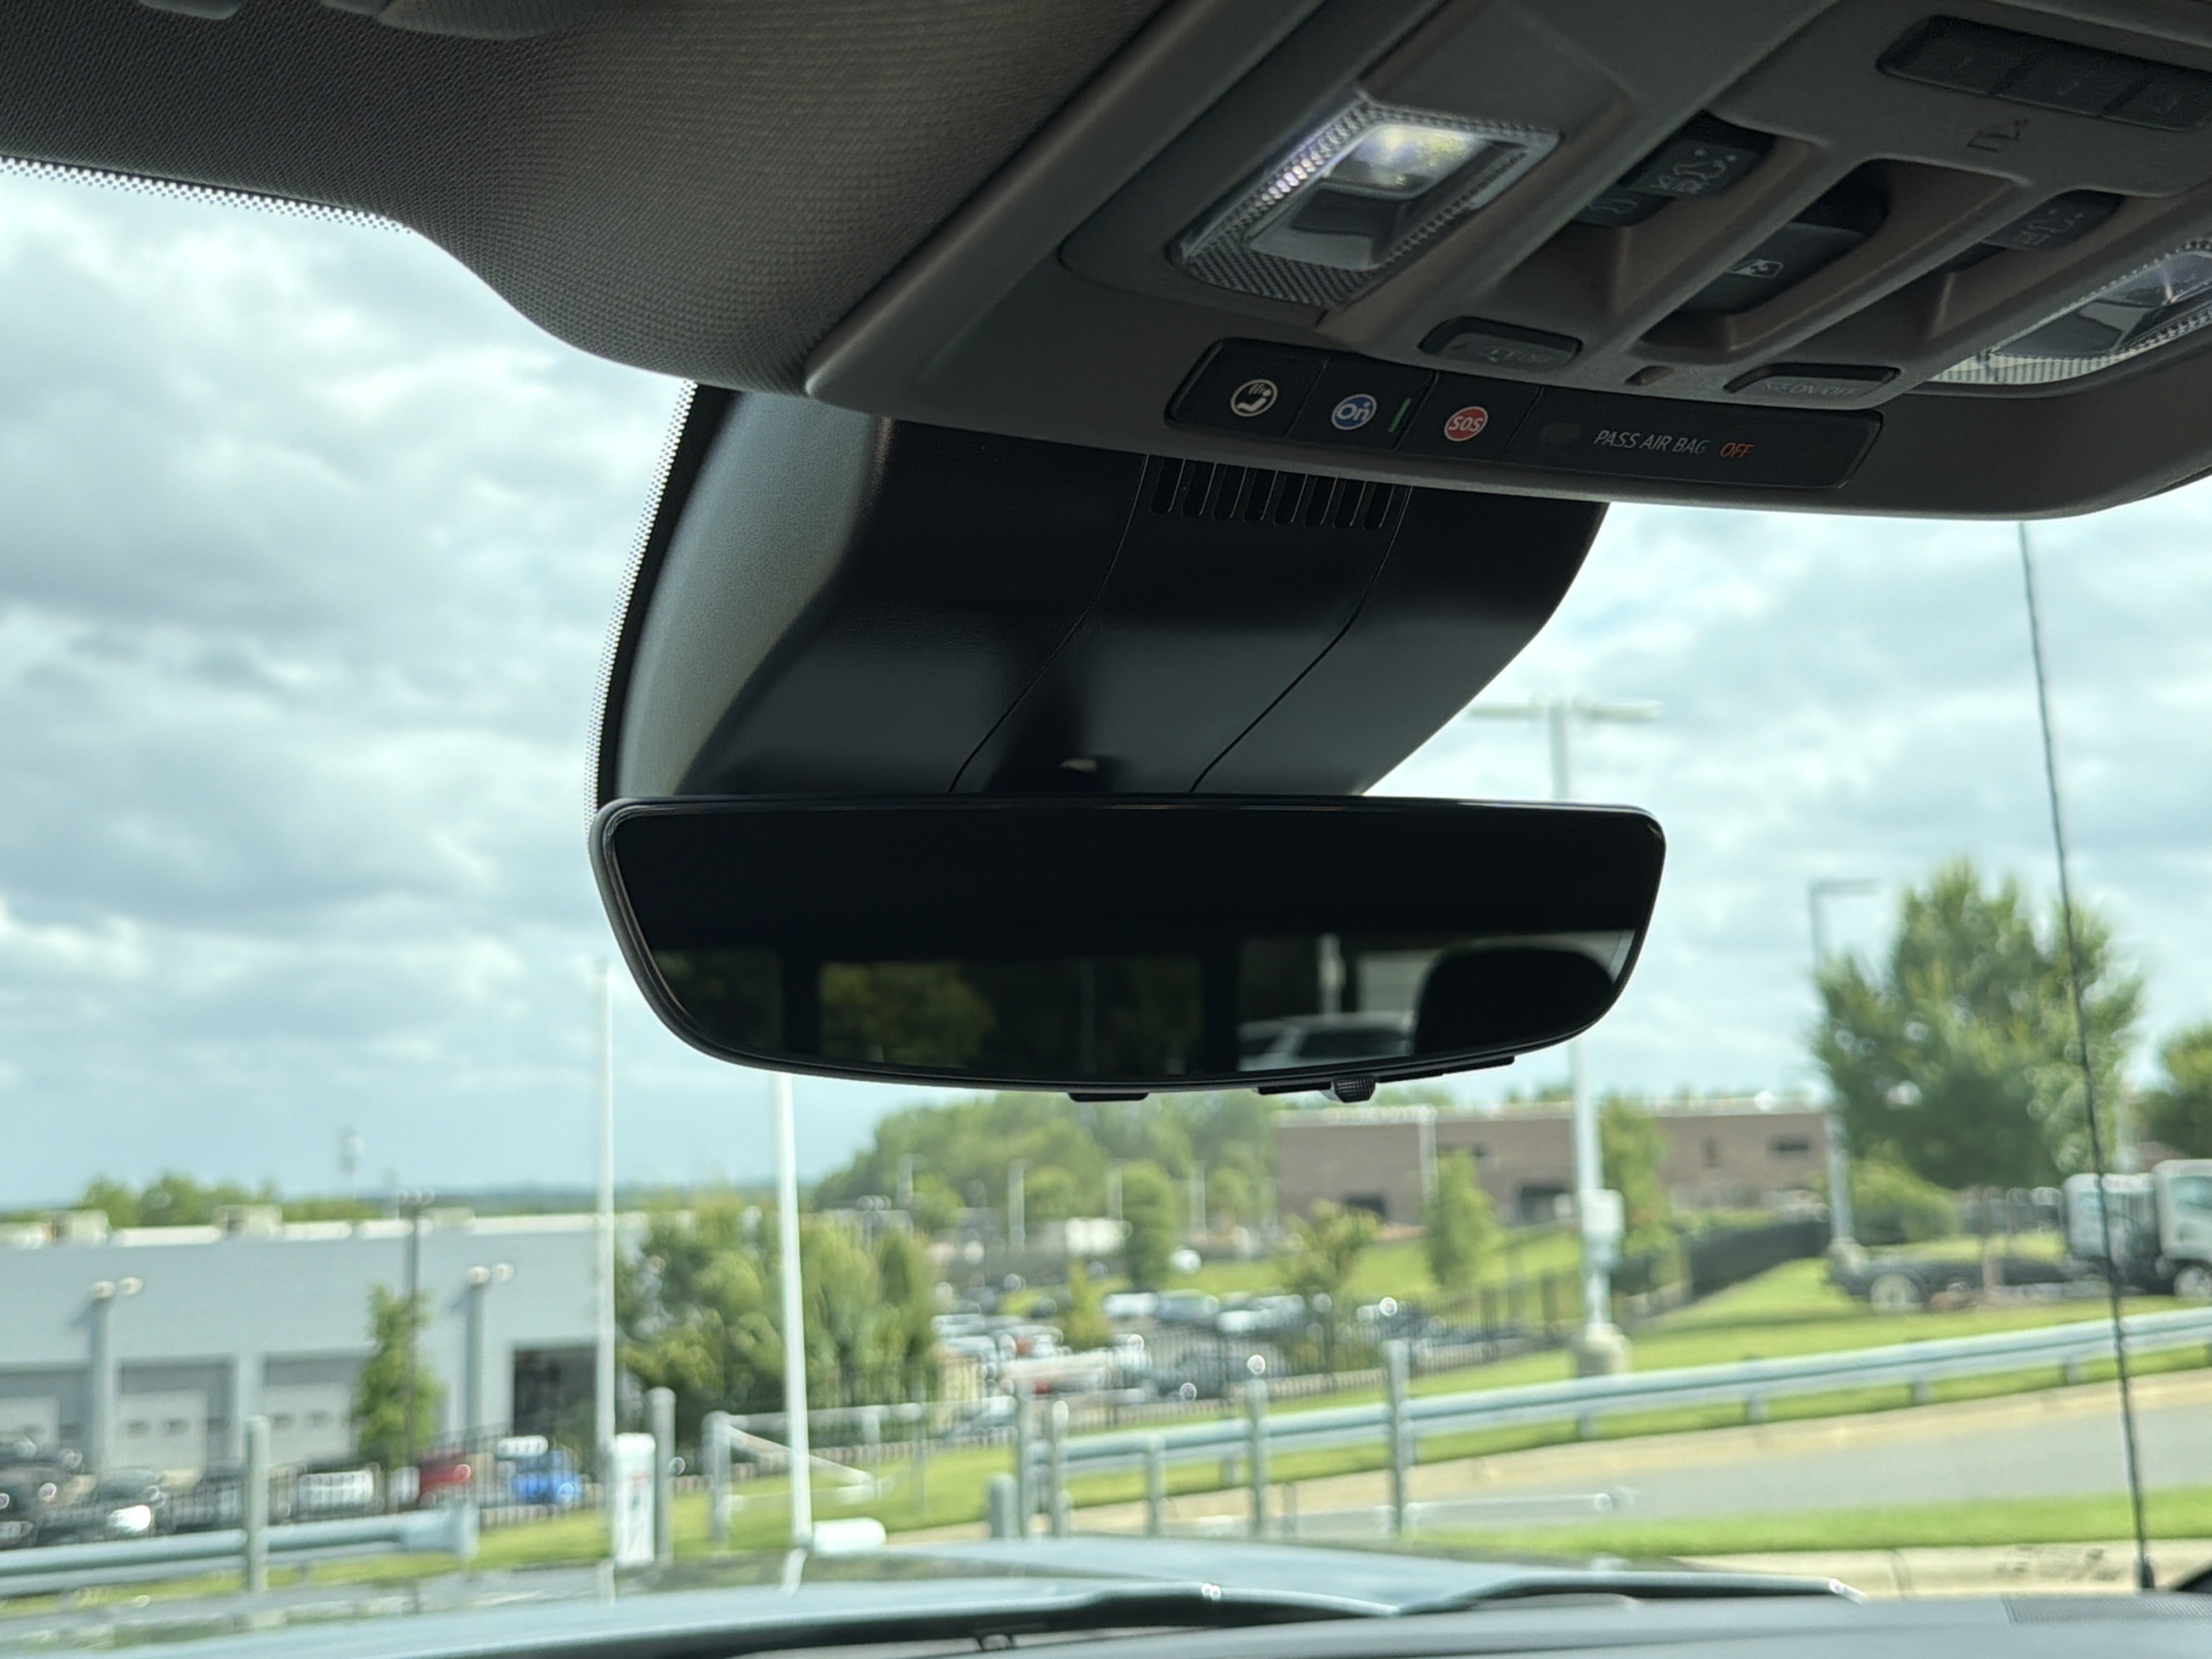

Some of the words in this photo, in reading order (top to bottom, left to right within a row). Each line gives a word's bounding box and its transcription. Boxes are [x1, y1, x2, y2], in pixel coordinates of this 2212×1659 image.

[1337, 404, 1370, 421] On
[1449, 415, 1484, 432] SOS
[1593, 430, 1640, 449] PASS
[1639, 434, 1673, 451] AIR
[1673, 437, 1710, 455] BAG
[1719, 442, 1754, 458] OFF
